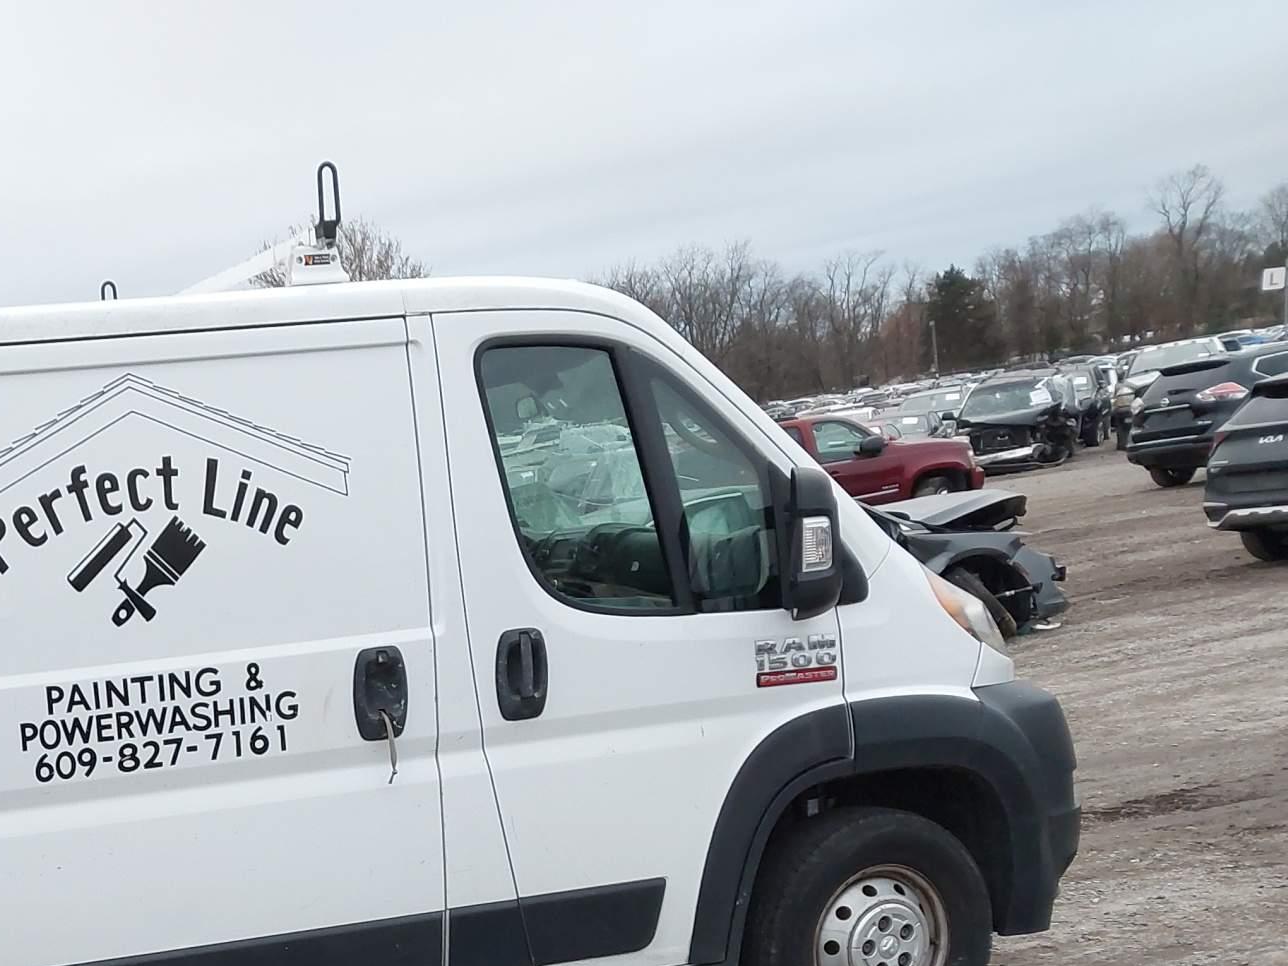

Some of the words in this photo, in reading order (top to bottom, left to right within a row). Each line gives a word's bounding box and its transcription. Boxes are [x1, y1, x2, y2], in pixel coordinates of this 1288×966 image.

[202, 457, 304, 546] Line
[755, 634, 836, 655] RAM
[756, 650, 837, 671] 1500
[45, 667, 222, 716] PAINTING
[245, 662, 264, 692] &
[19, 690, 299, 752] POWERWASHING
[35, 724, 287, 783] 609-827-7161
